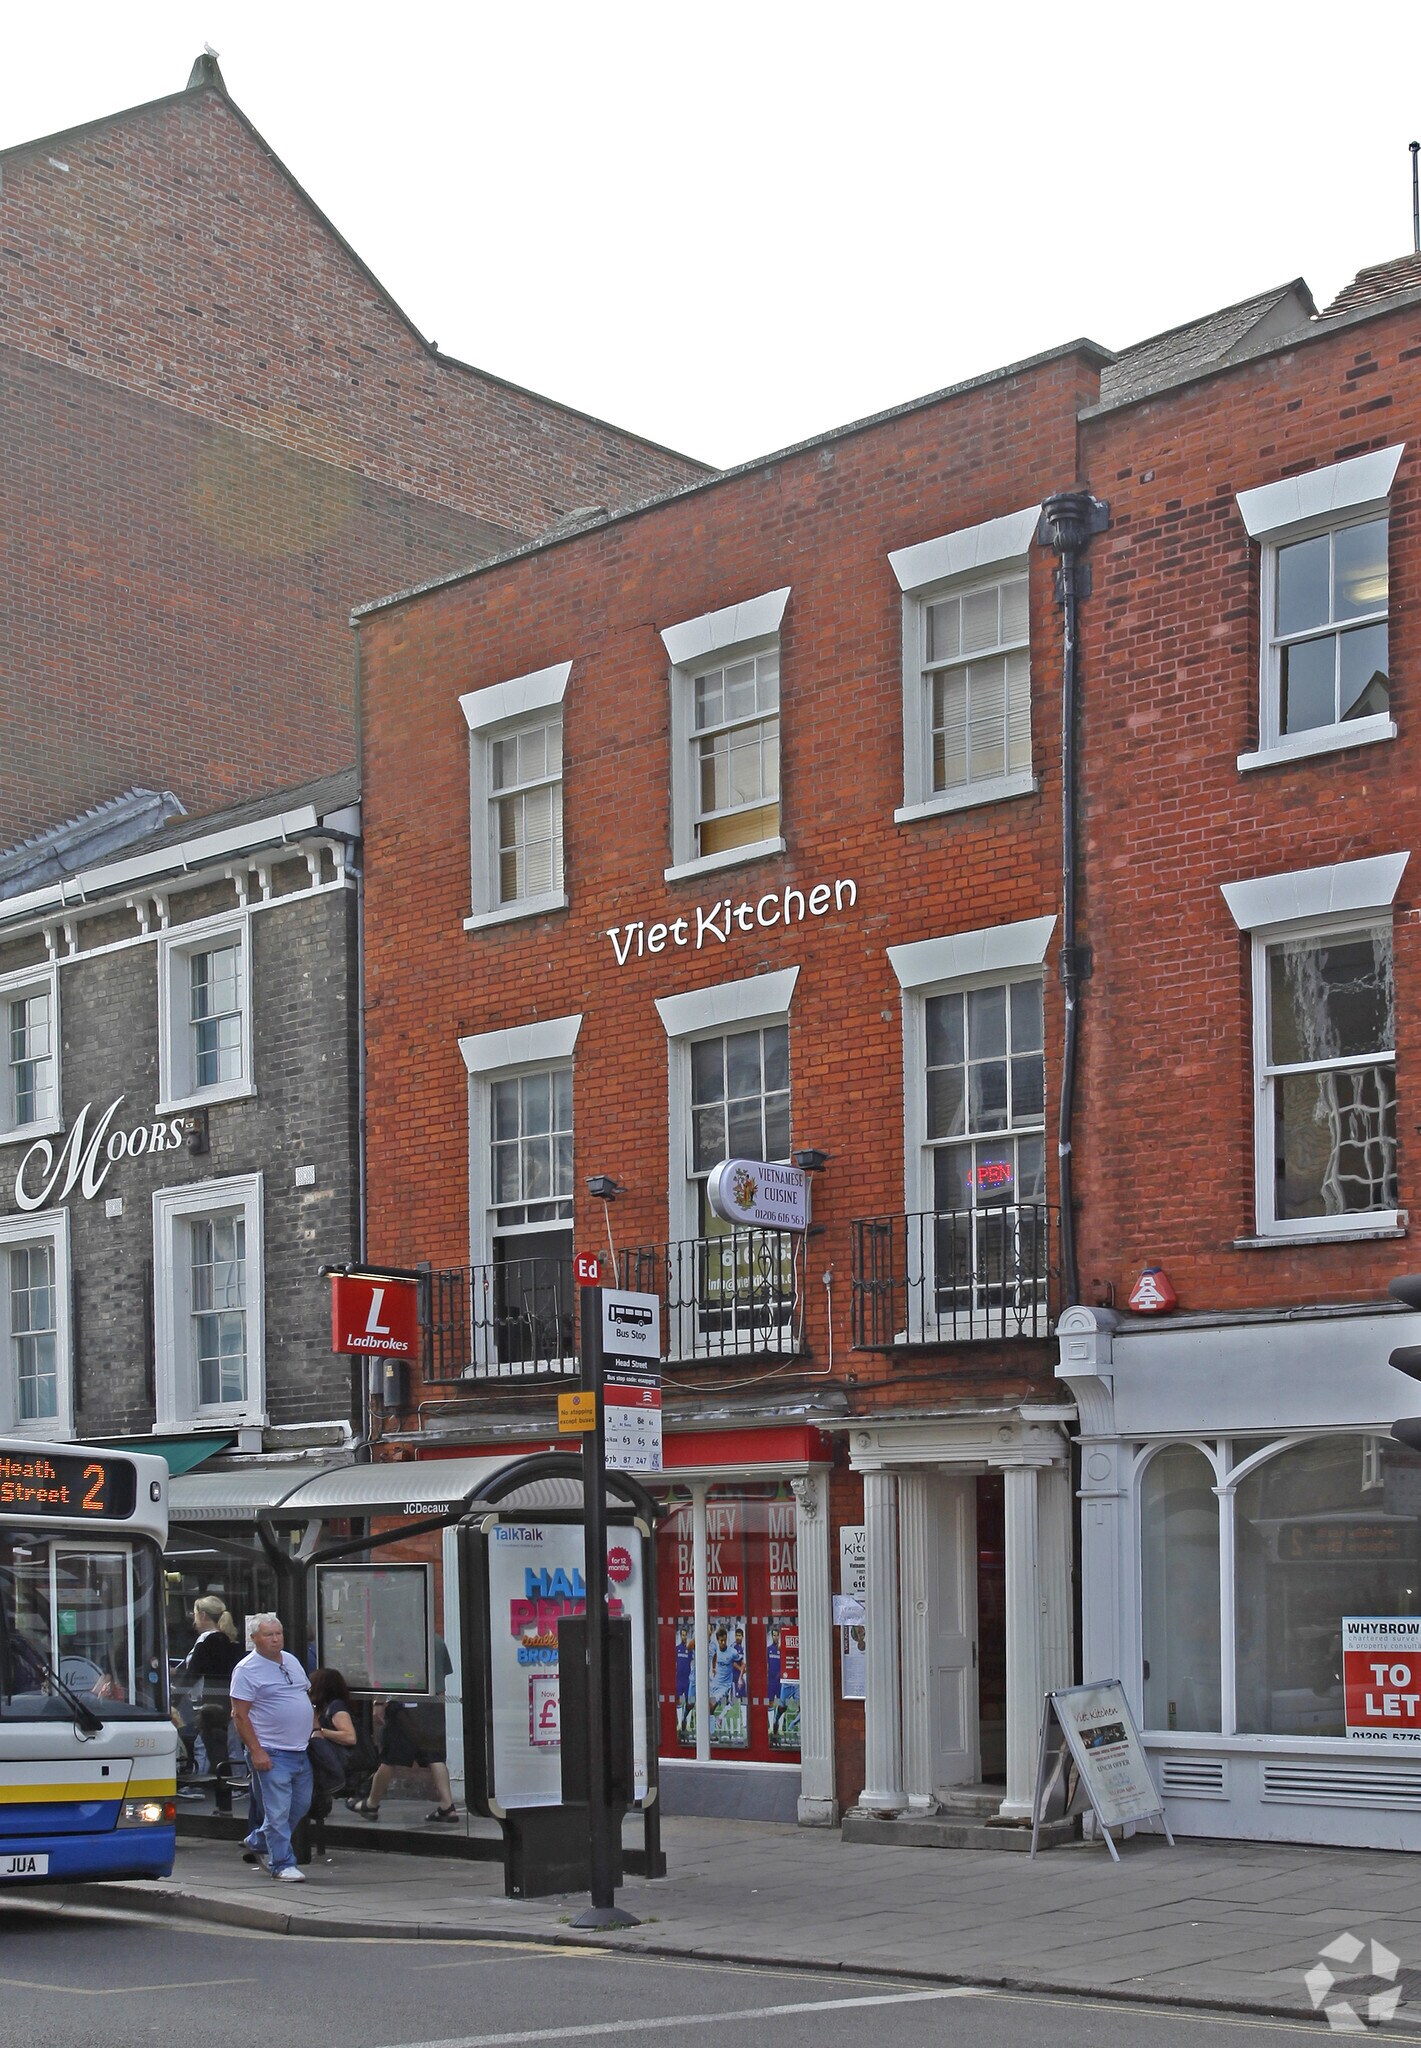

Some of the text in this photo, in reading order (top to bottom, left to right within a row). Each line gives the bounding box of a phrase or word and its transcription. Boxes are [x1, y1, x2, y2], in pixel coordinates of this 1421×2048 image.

[606, 878, 857, 965] Viet Kitchen
[758, 1167, 803, 1187] VIETNAMESE
[764, 1187, 798, 1204] CUISINE
[755, 1209, 804, 1225] 01206 616 563
[579, 1259, 598, 1278] Ed
[365, 1288, 390, 1334] L
[616, 1328, 647, 1341] Bus Stop
[347, 1334, 408, 1350] Ladbrokes
[615, 1358, 648, 1369] Head Street
[570, 1408, 593, 1416] stopping
[623, 1413, 628, 1421] 8
[622, 1435, 631, 1445] 63
[637, 1437, 646, 1447] 65
[651, 1438, 659, 1447] 66
[605, 1454, 617, 1464] 67b
[623, 1456, 631, 1464] 87
[0, 1458, 106, 1511] Heath 2
[0, 1481, 70, 1504] Street
[403, 1502, 450, 1514] JCDecaux
[677, 1509, 736, 1541] MNEY
[493, 1528, 544, 1541] TalkTalk
[844, 1543, 866, 1555] Kitc
[611, 1556, 620, 1564] for
[525, 1567, 586, 1598] HAL
[722, 1576, 738, 1590] WIN
[778, 1576, 797, 1590] MAN
[1347, 1623, 1420, 1634] WHYBROW
[1356, 1642, 1388, 1650] property
[518, 1647, 559, 1663] BROA
[1369, 1664, 1412, 1688] TO
[1365, 1693, 1420, 1717] LET
[1089, 1706, 1118, 1720] Kitchen
[1352, 1731, 1388, 1740] 01206
[6, 1857, 37, 1874] JUA
